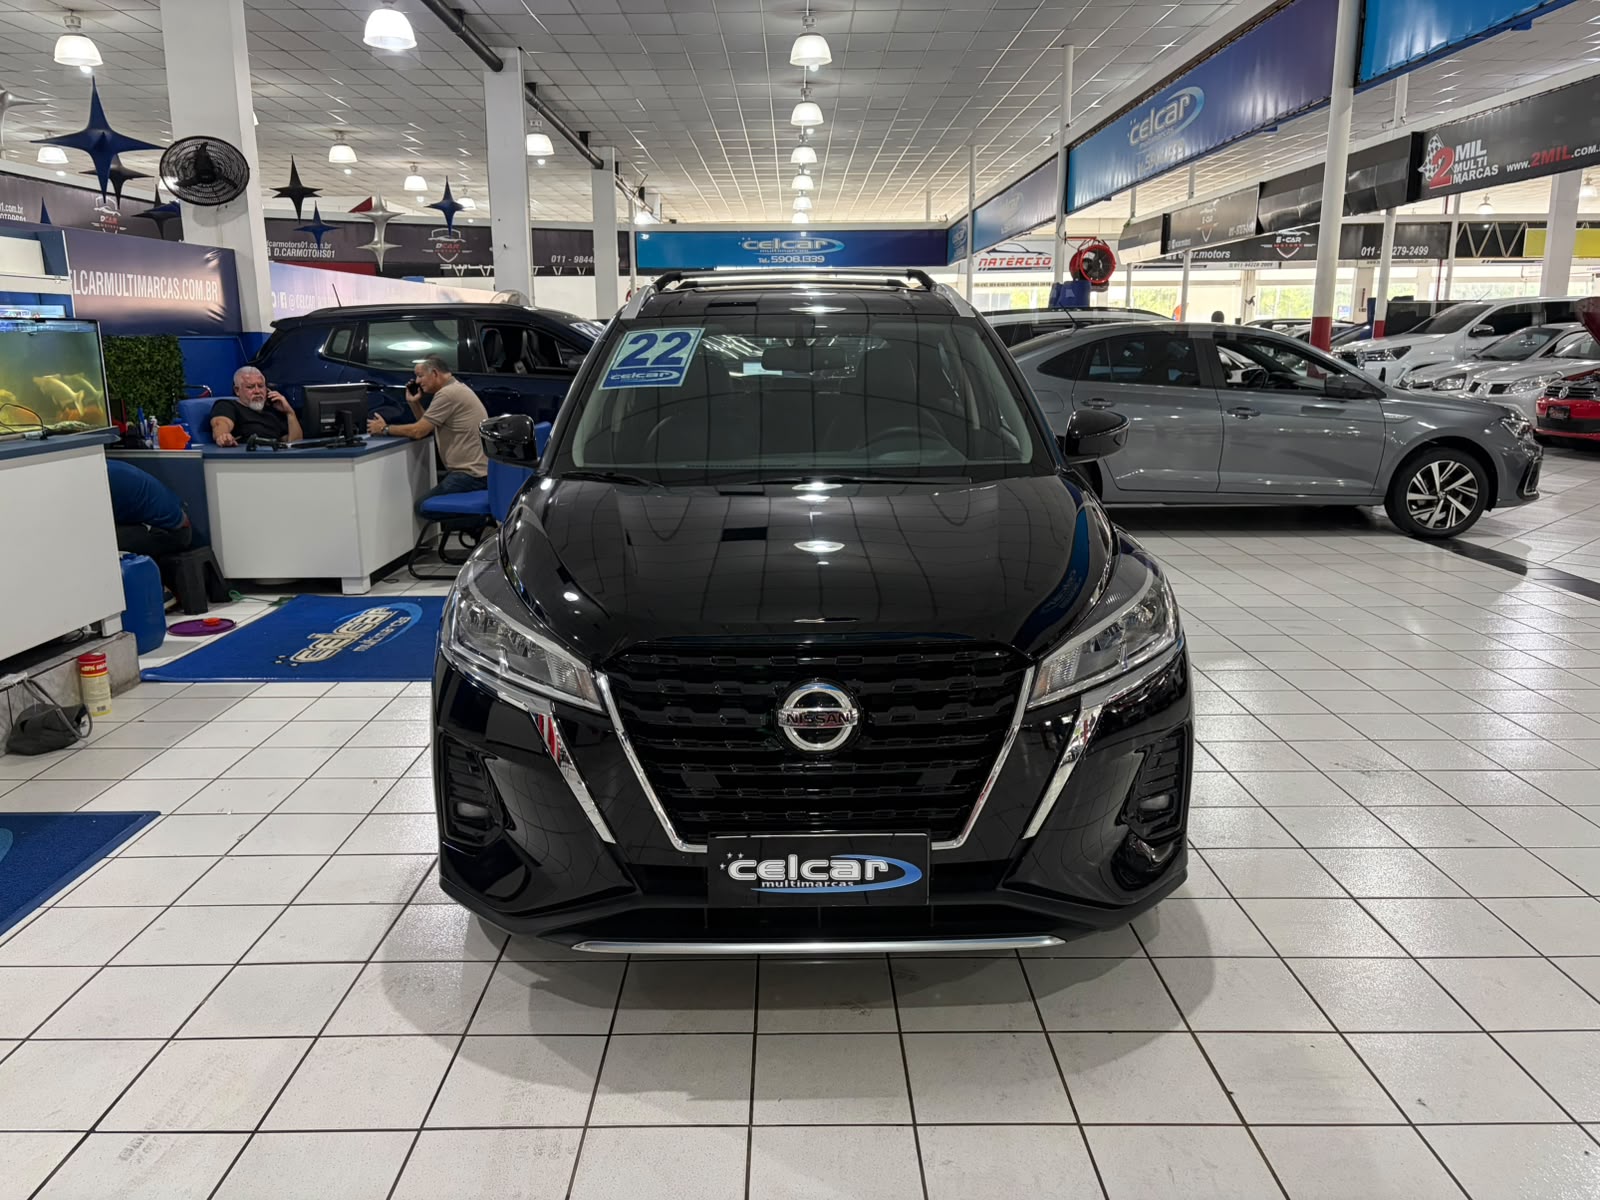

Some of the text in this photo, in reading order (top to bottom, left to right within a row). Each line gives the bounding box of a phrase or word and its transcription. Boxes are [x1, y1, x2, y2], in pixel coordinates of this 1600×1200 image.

[1130, 93, 1190, 145] celcar
[1429, 139, 1487, 189] 2 MIL
[1453, 156, 1488, 174] MULTI
[1453, 165, 1499, 185] MARCAS
[742, 238, 828, 250] celcar
[1391, 246, 1429, 256] 279-2499
[551, 255, 566, 263] 011
[573, 255, 595, 264] 9844
[71, 268, 218, 302] LCARMULTIMARCAS.COM.BR
[616, 331, 692, 367] 22
[786, 713, 850, 725] NISSAN
[727, 853, 889, 881] celcar
[761, 880, 854, 888] multimarcas
